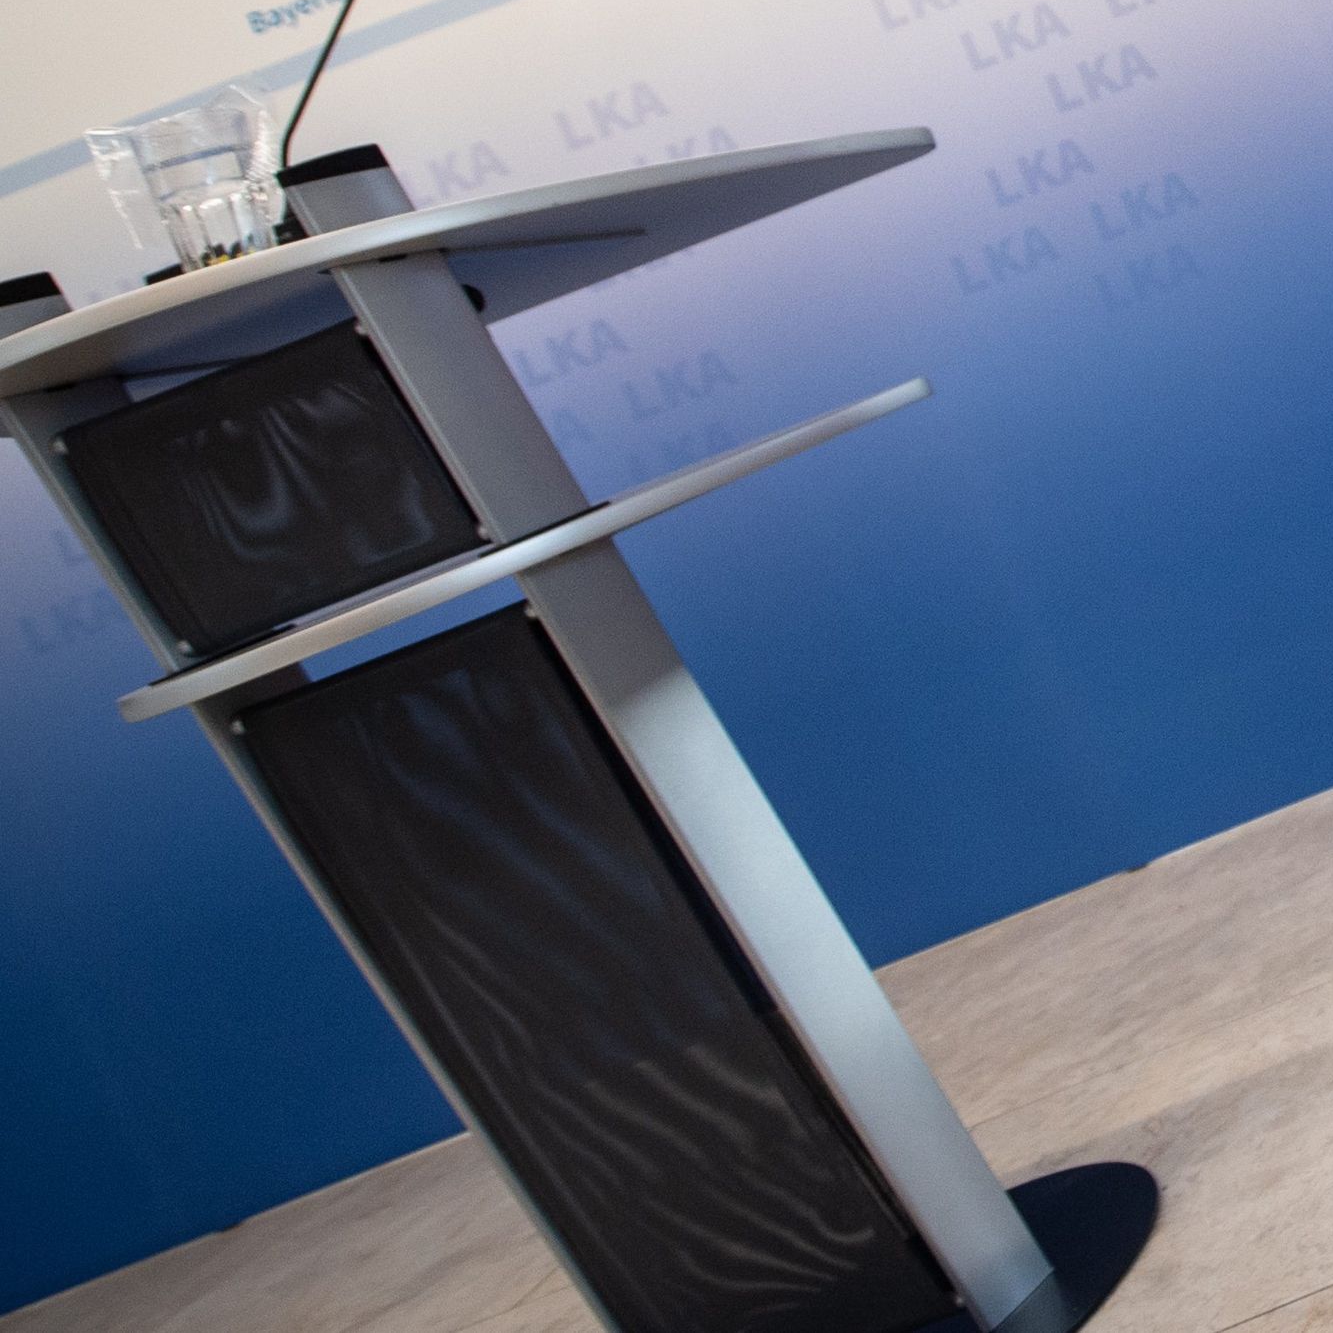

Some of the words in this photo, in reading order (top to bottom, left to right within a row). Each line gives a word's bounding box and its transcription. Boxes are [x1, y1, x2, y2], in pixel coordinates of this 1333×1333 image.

[958, 0, 1072, 72] LKA
[1044, 42, 1160, 113] LKA
[552, 79, 671, 153] LKA
[985, 138, 1097, 208] LKA
[1089, 170, 1202, 242] LKA
[948, 224, 1062, 297] LKA
[515, 317, 631, 388] LKA
[618, 348, 740, 422] LKA
